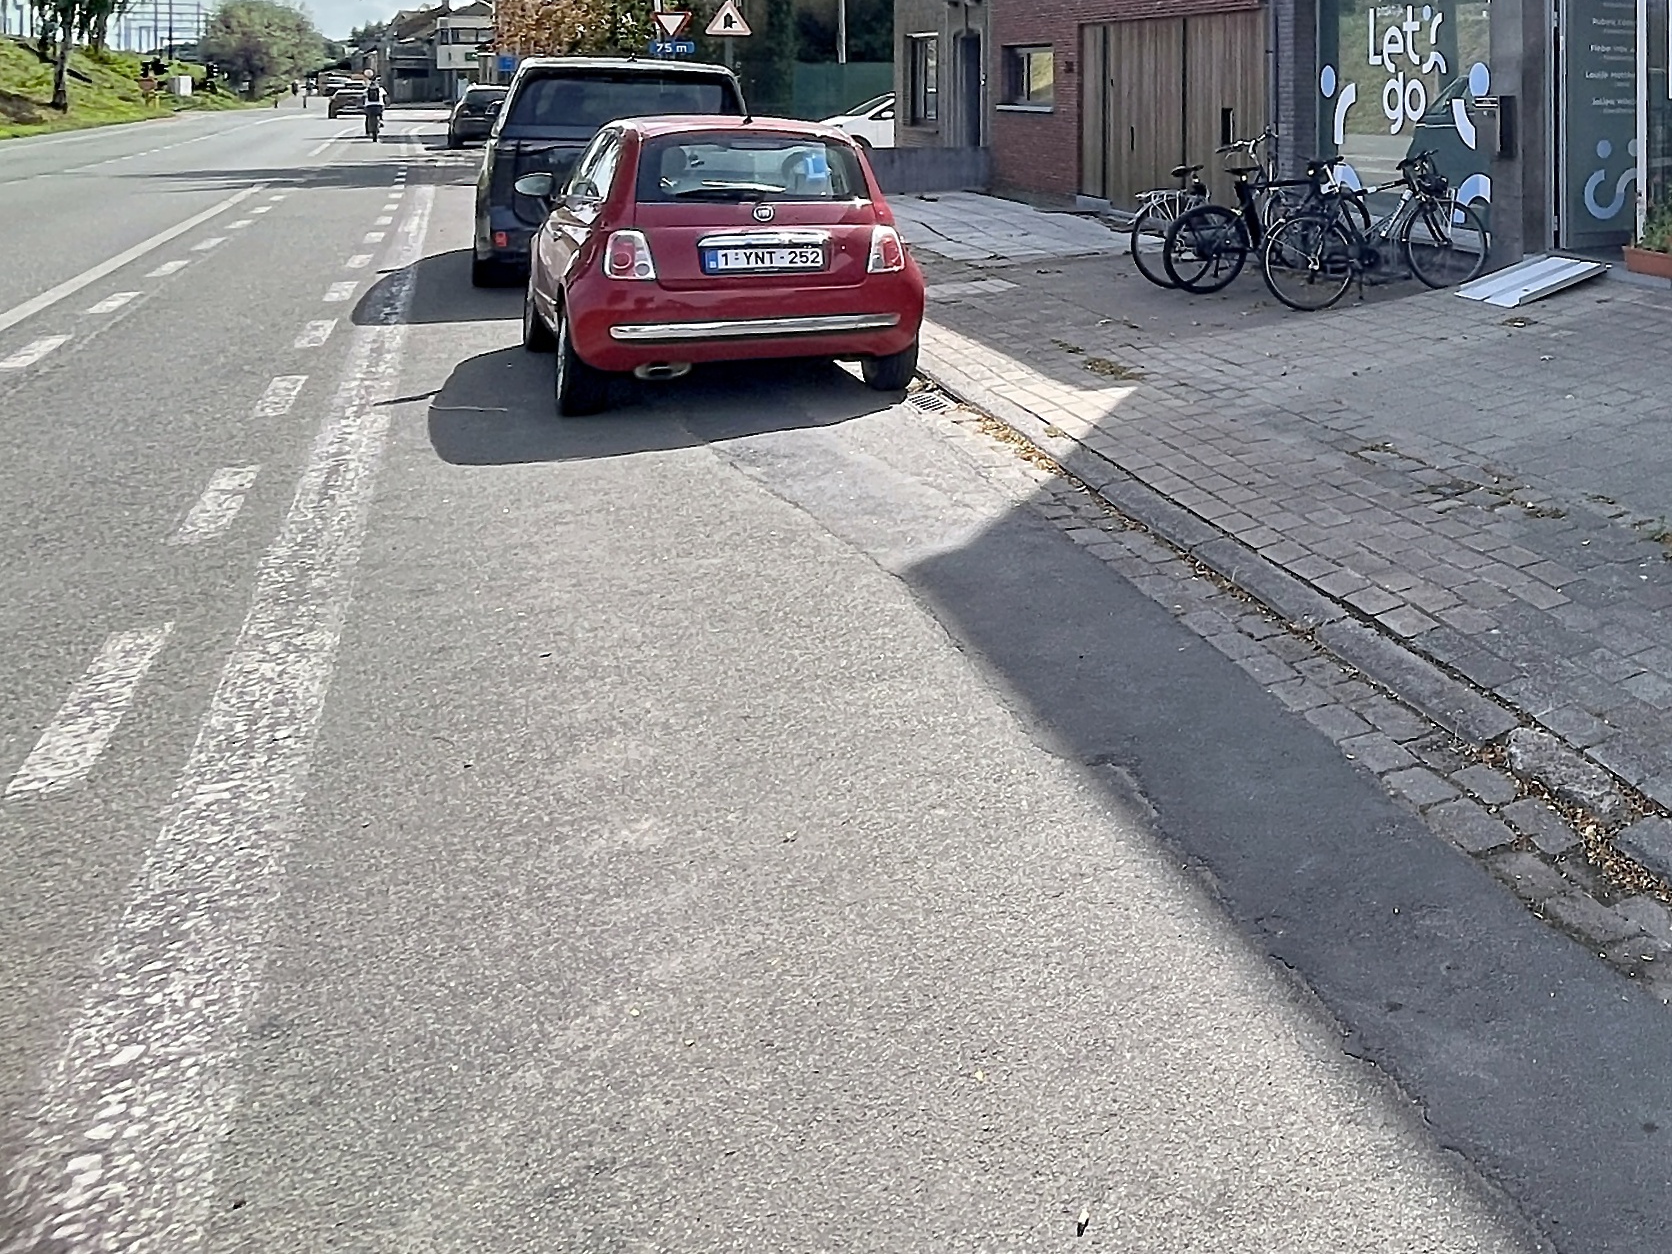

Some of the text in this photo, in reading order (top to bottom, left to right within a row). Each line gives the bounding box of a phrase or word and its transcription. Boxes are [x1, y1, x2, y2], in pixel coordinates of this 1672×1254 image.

[656, 43, 687, 53] 75 m
[1383, 71, 1427, 135] go
